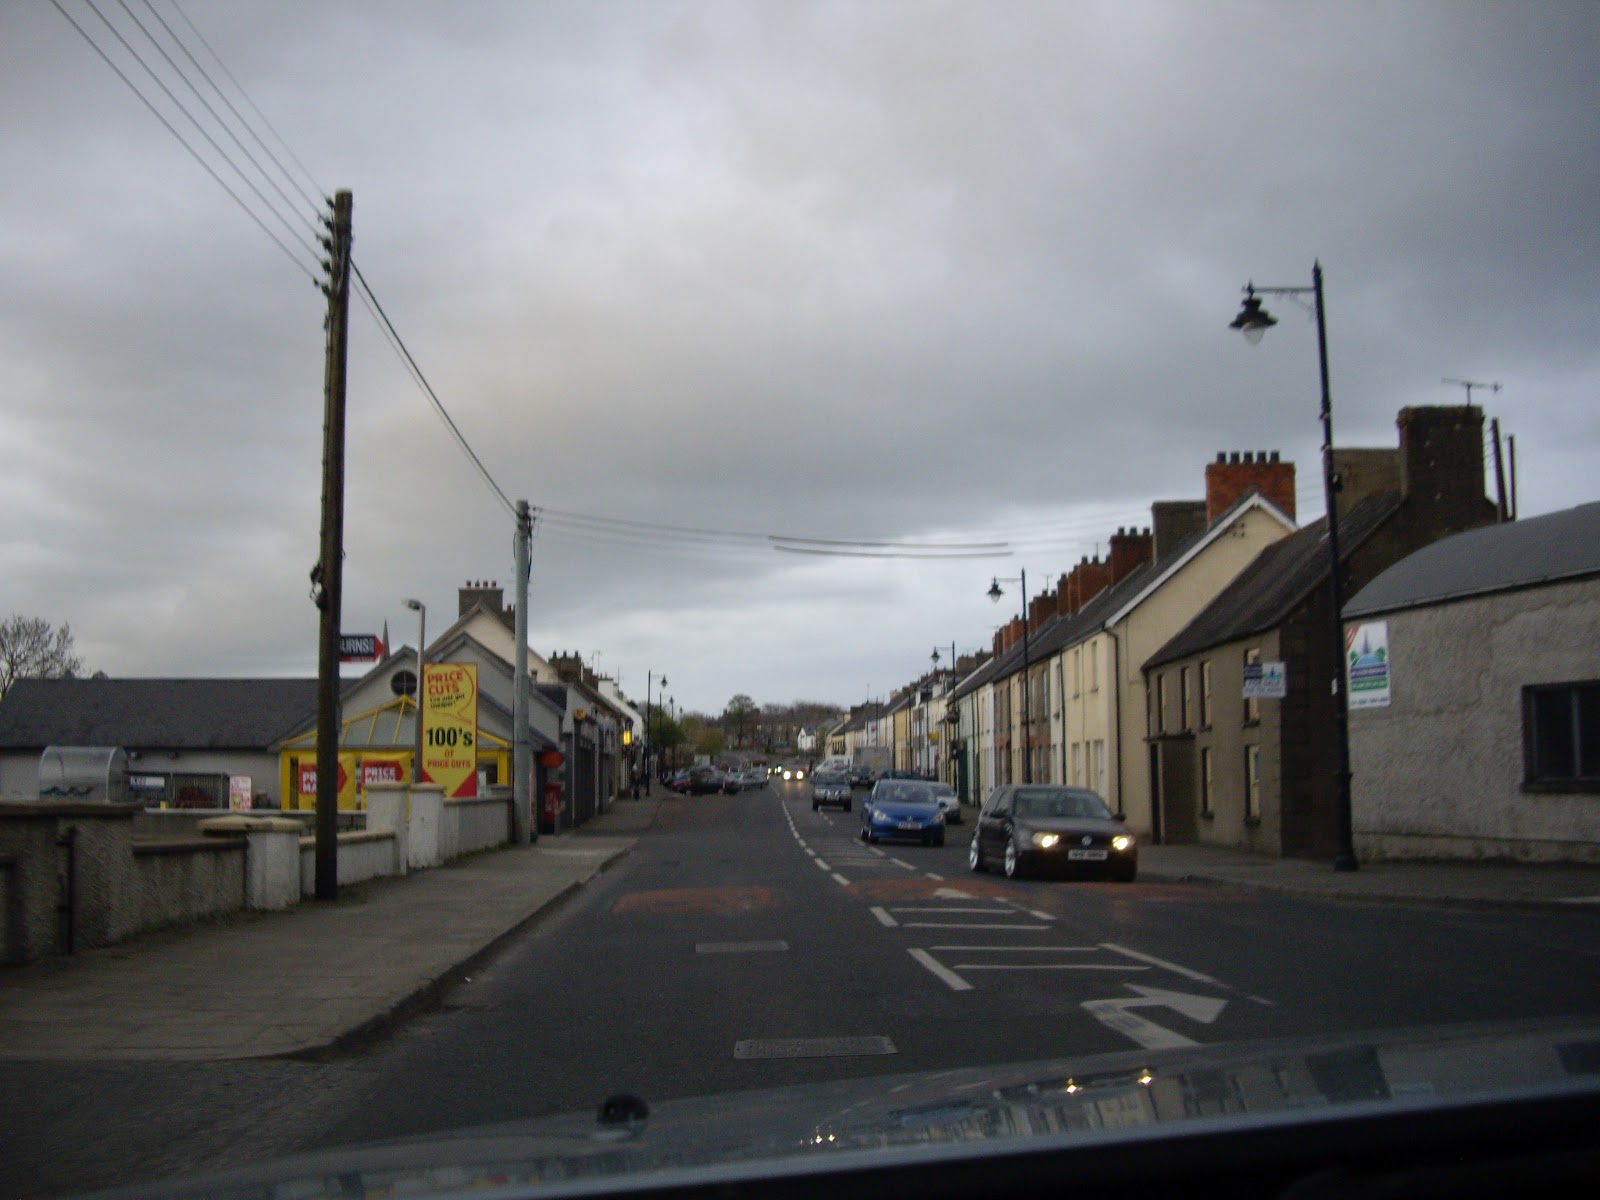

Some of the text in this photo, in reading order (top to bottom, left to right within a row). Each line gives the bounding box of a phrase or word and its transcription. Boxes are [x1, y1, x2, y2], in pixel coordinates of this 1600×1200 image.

[427, 671, 463, 684] PRICE
[428, 682, 460, 695] CUTS
[426, 727, 473, 747] 100's
[444, 749, 454, 757] OF
[427, 760, 471, 769] PRICE CUTS
[364, 767, 396, 780] PRICE
